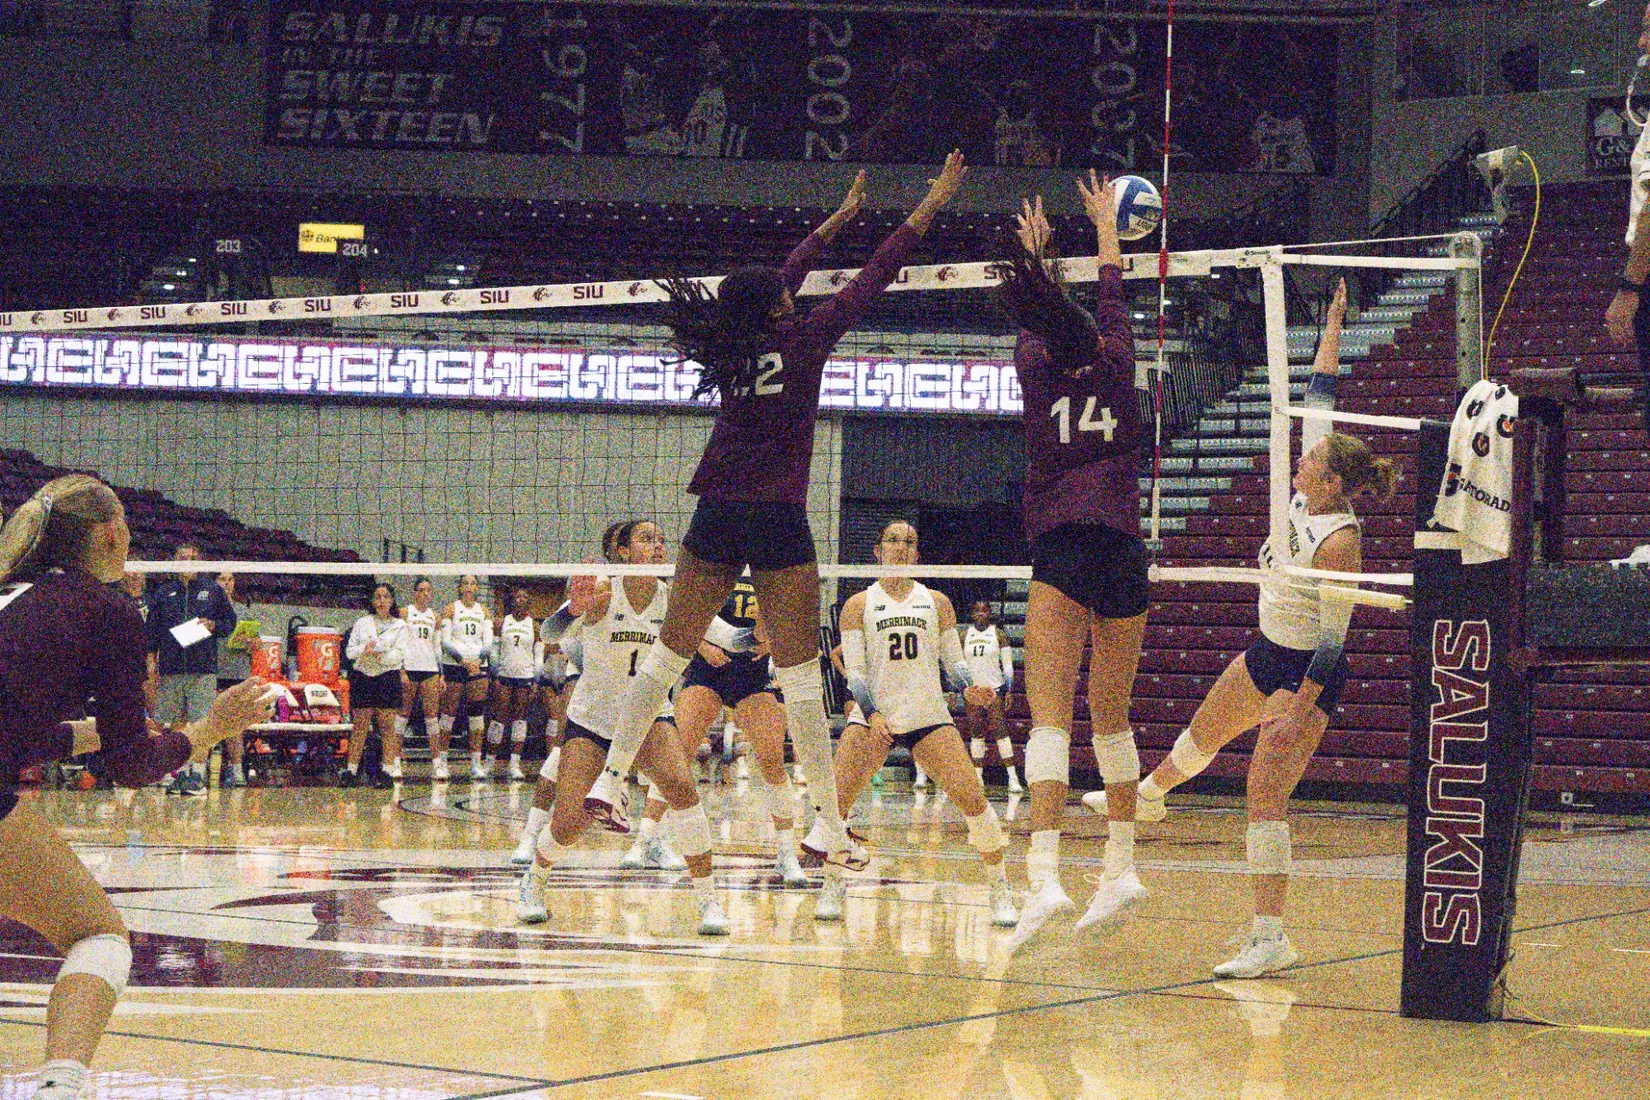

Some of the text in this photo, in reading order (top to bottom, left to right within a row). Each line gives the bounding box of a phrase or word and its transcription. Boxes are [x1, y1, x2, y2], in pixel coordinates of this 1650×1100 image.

[281, 11, 506, 46] SALUKIS
[280, 47, 380, 66] IN THE
[279, 70, 453, 104] SWEET
[539, 8, 588, 153] 1977
[805, 17, 853, 161] 2002
[277, 108, 494, 144] SIXTEEN
[216, 239, 241, 253] 203
[342, 242, 368, 257] 204
[480, 290, 509, 304] SIU
[573, 285, 604, 300] SIU
[304, 299, 332, 312] SIU
[390, 294, 419, 308] SIU
[140, 306, 166, 320] SIU
[220, 303, 247, 316] SIU
[63, 311, 88, 324] SIU
[1050, 396, 1118, 444] 14
[734, 594, 759, 619] 12
[464, 622, 477, 636] 13
[876, 616, 927, 632] MERRIMACK
[417, 627, 430, 639] 19
[512, 634, 521, 647] 7
[268, 645, 278, 657] G
[321, 643, 333, 657] G
[889, 632, 918, 660] 20
[972, 644, 985, 657] 17
[628, 649, 639, 677] 1
[1422, 619, 1490, 946] SALUKIS
